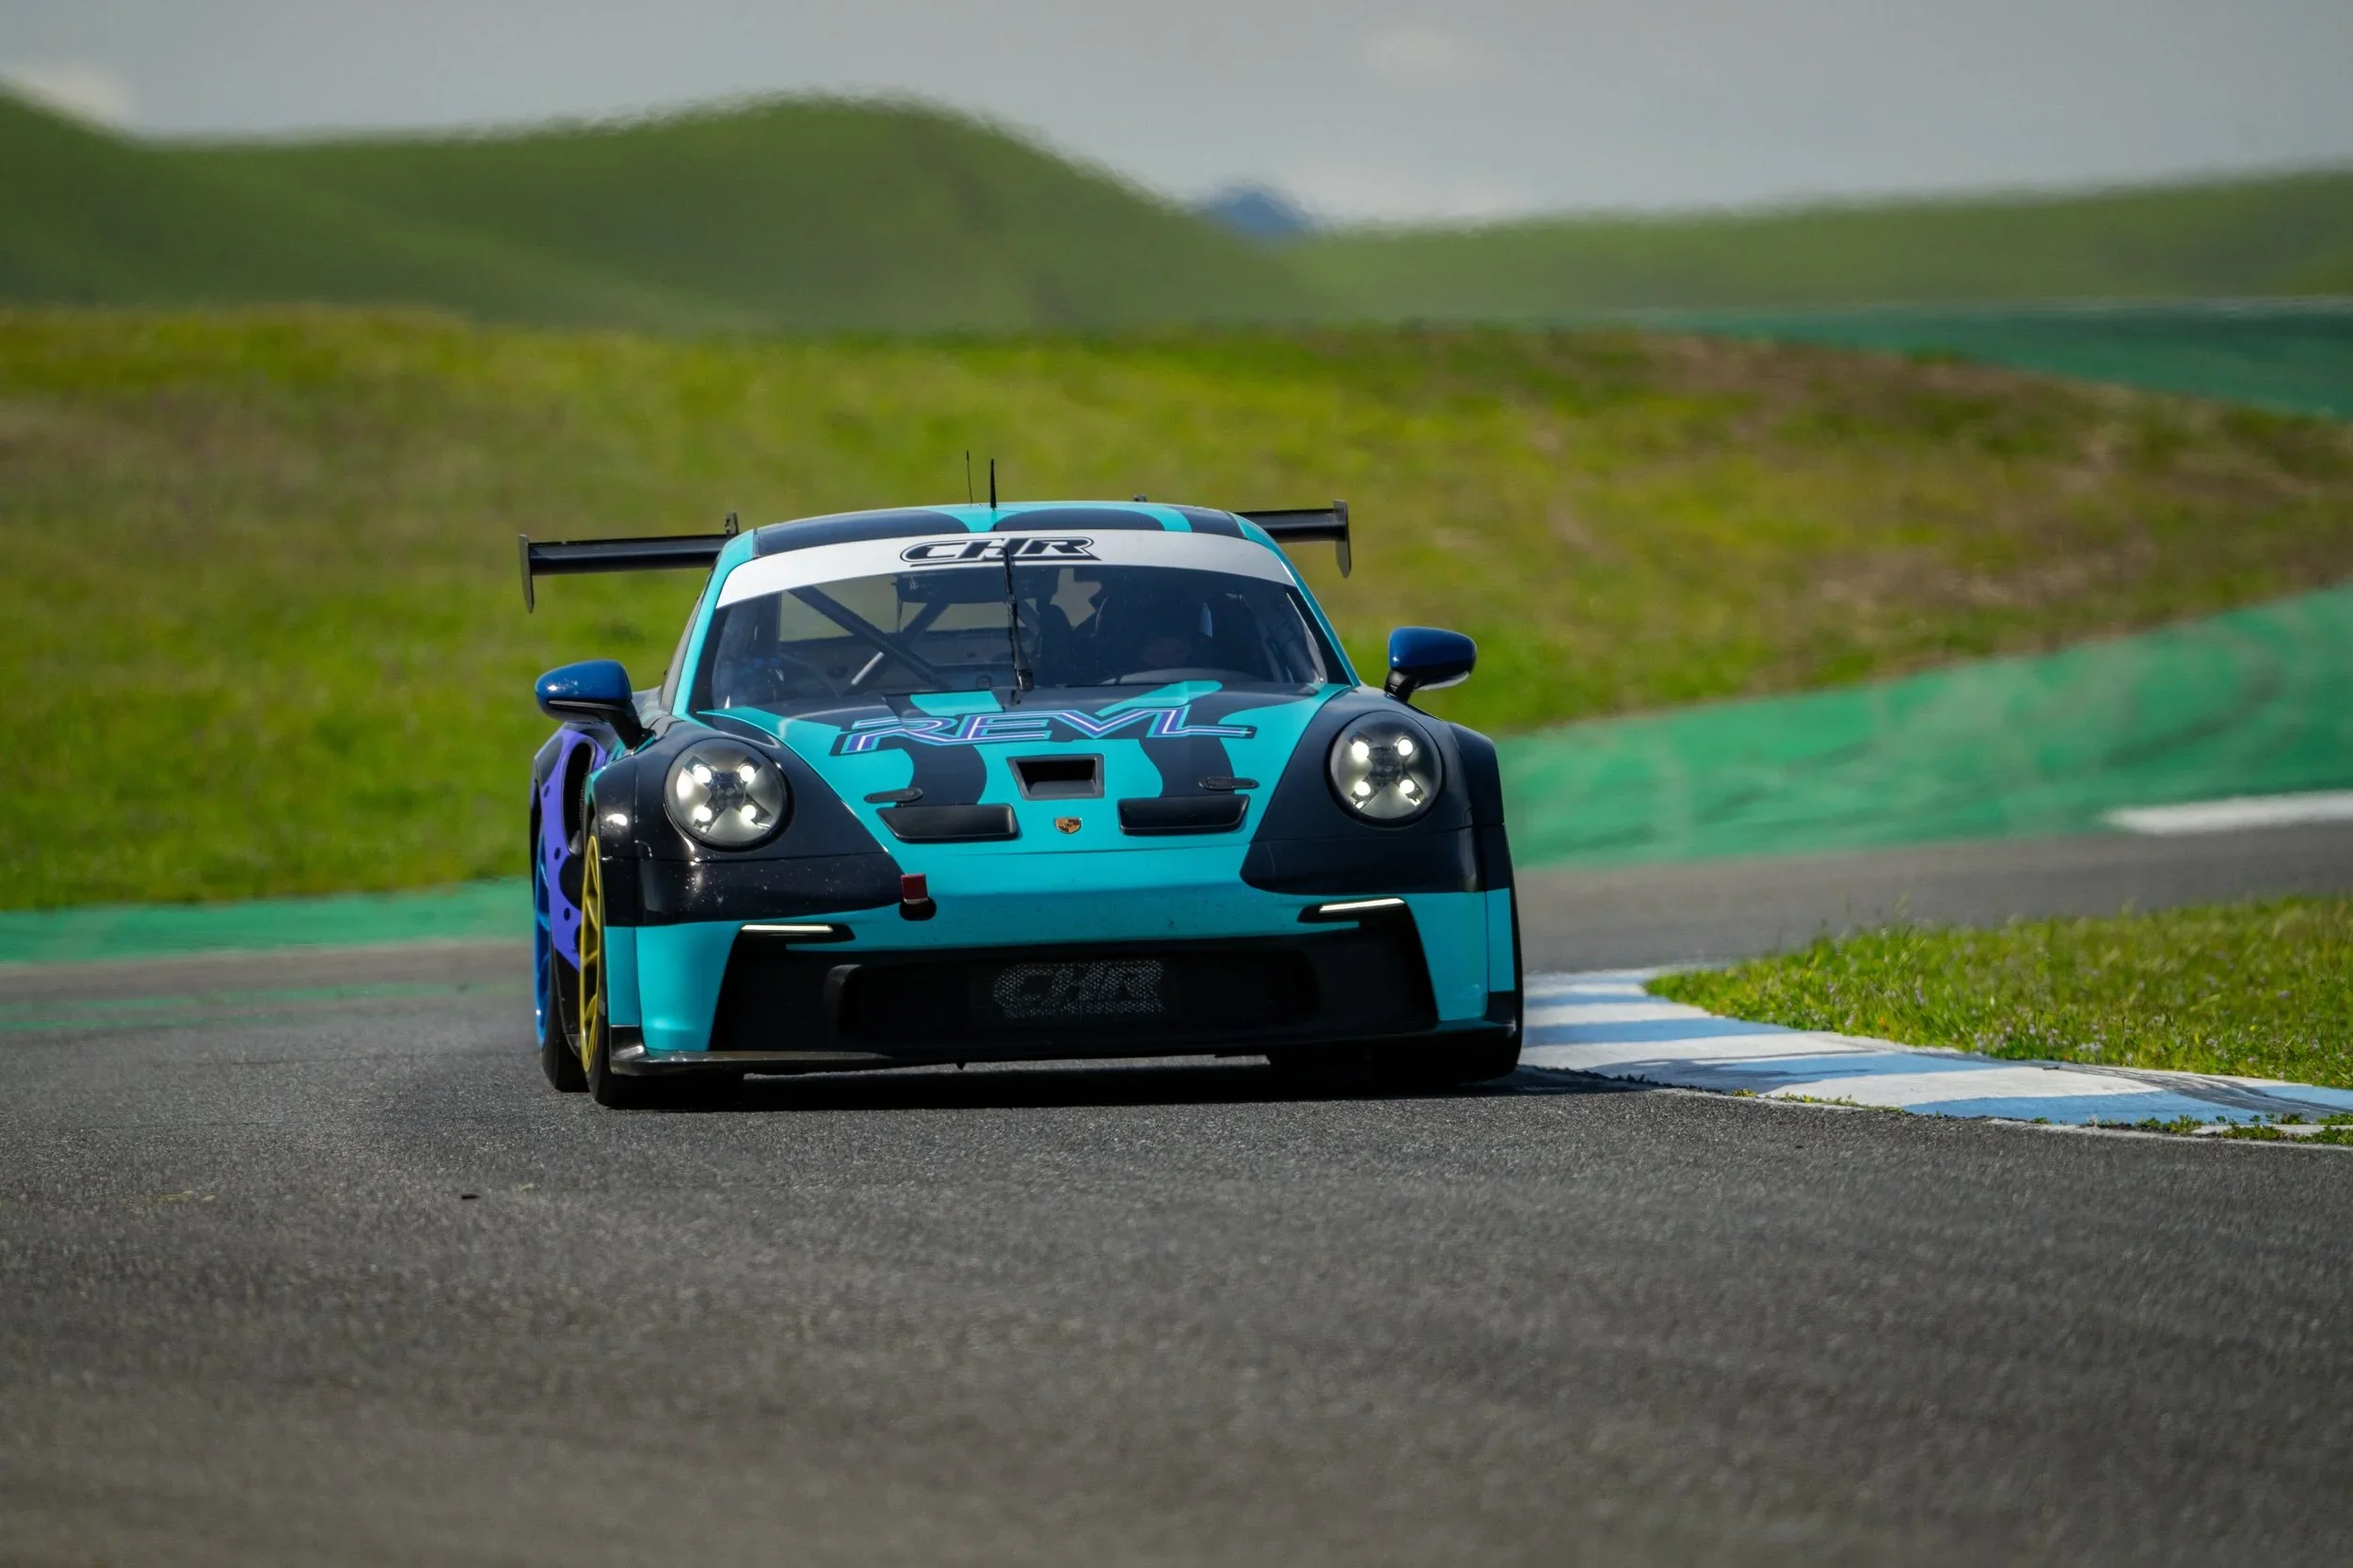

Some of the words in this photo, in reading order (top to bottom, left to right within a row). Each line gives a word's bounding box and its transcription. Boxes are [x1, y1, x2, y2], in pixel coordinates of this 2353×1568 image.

[901, 536, 1099, 567] CHR
[834, 706, 1255, 755] REVL
[993, 961, 1165, 1017] CHR
